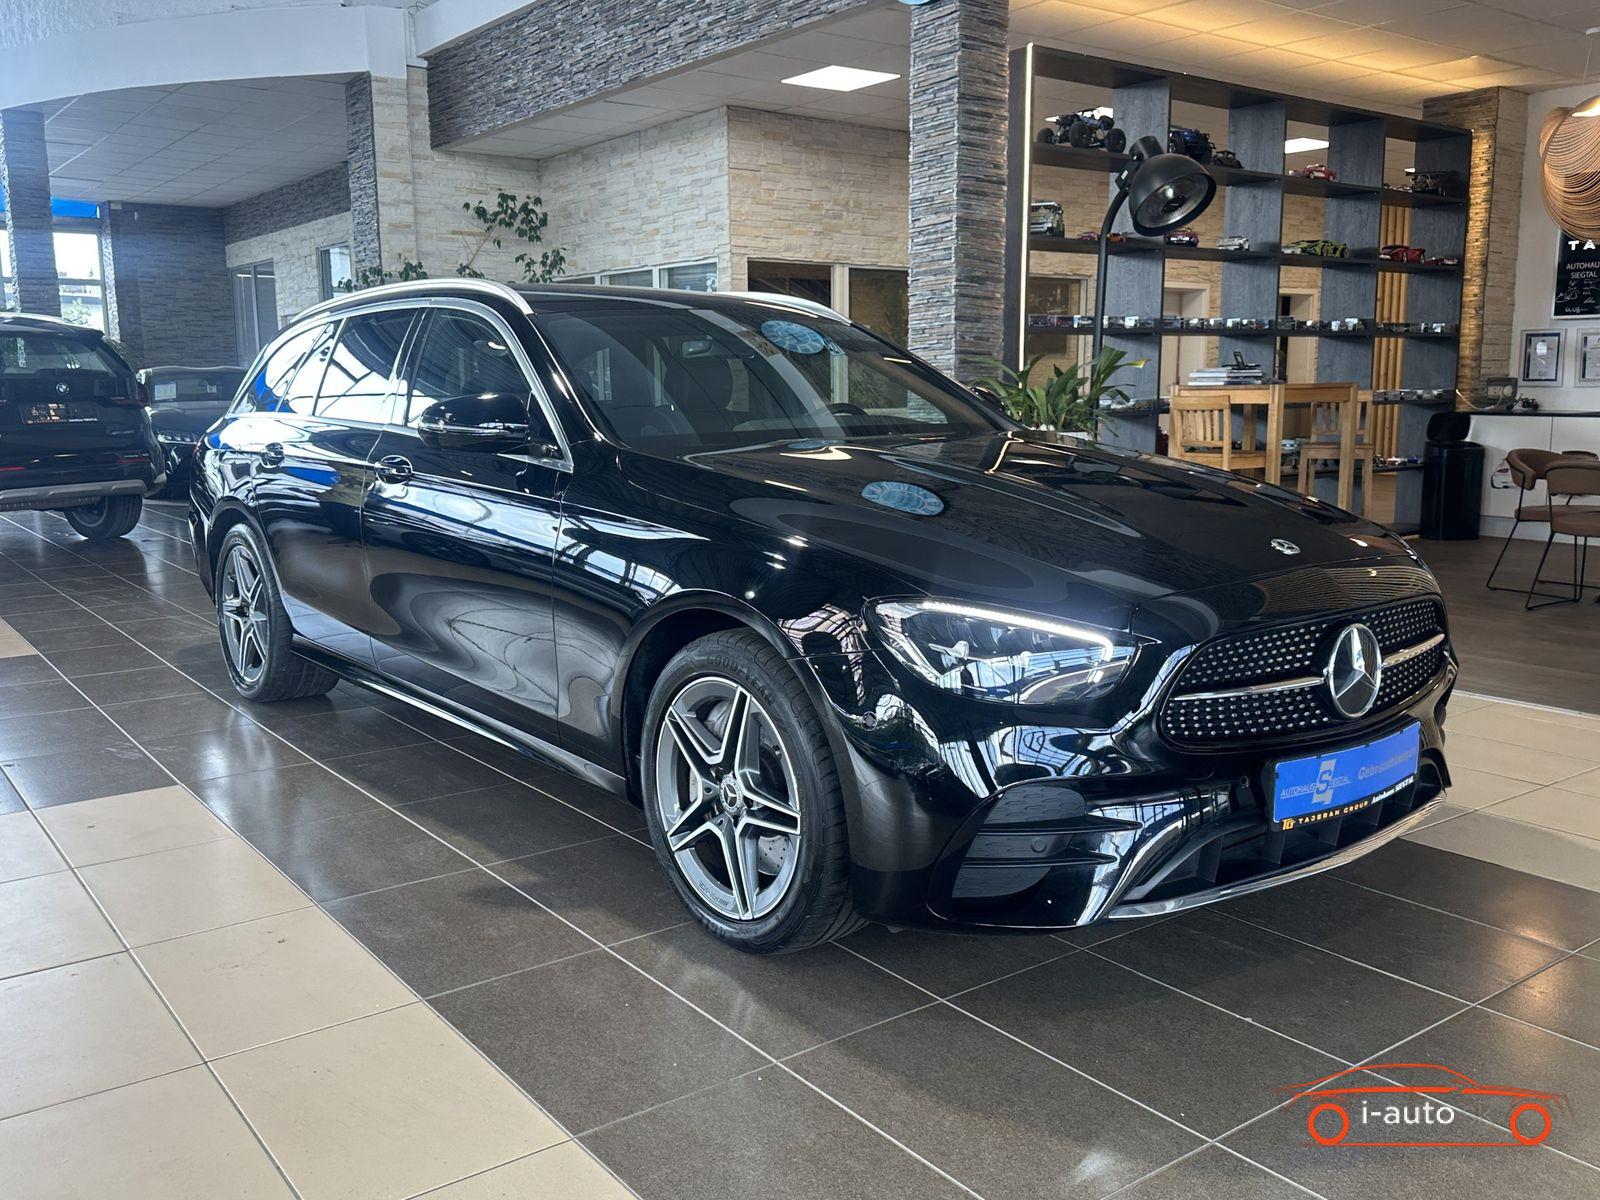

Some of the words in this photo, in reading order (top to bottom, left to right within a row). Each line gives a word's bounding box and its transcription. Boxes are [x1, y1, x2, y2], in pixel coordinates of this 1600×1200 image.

[1570, 271, 1598, 279] SIEGTAL
[1280, 783, 1316, 796] AUTOHAUS
[1343, 800, 1369, 814] GROUP
